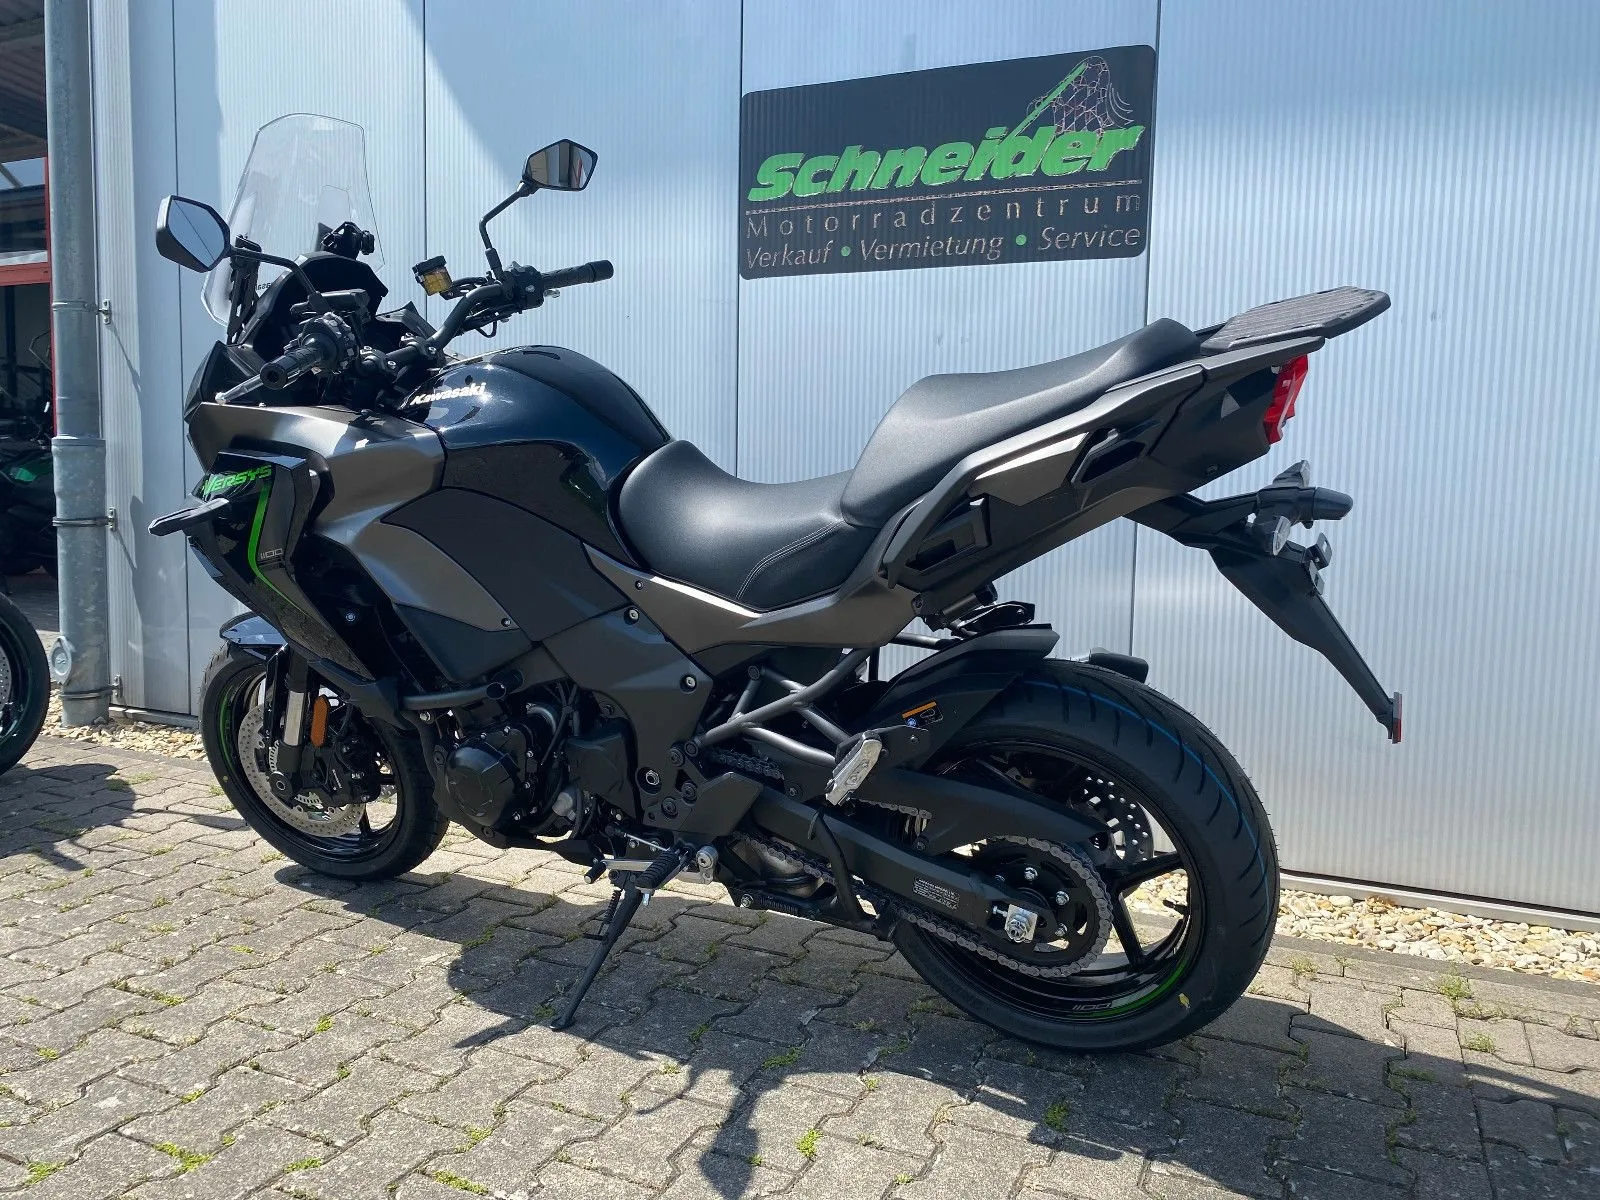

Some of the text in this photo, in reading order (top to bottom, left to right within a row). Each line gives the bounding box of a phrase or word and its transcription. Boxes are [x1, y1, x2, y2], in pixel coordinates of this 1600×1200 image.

[748, 125, 1145, 201] Schneider
[747, 194, 1140, 238] Motorradzentrum
[746, 225, 1140, 268] Verkauf Vermietung Service
[410, 382, 487, 405] Kawasaki
